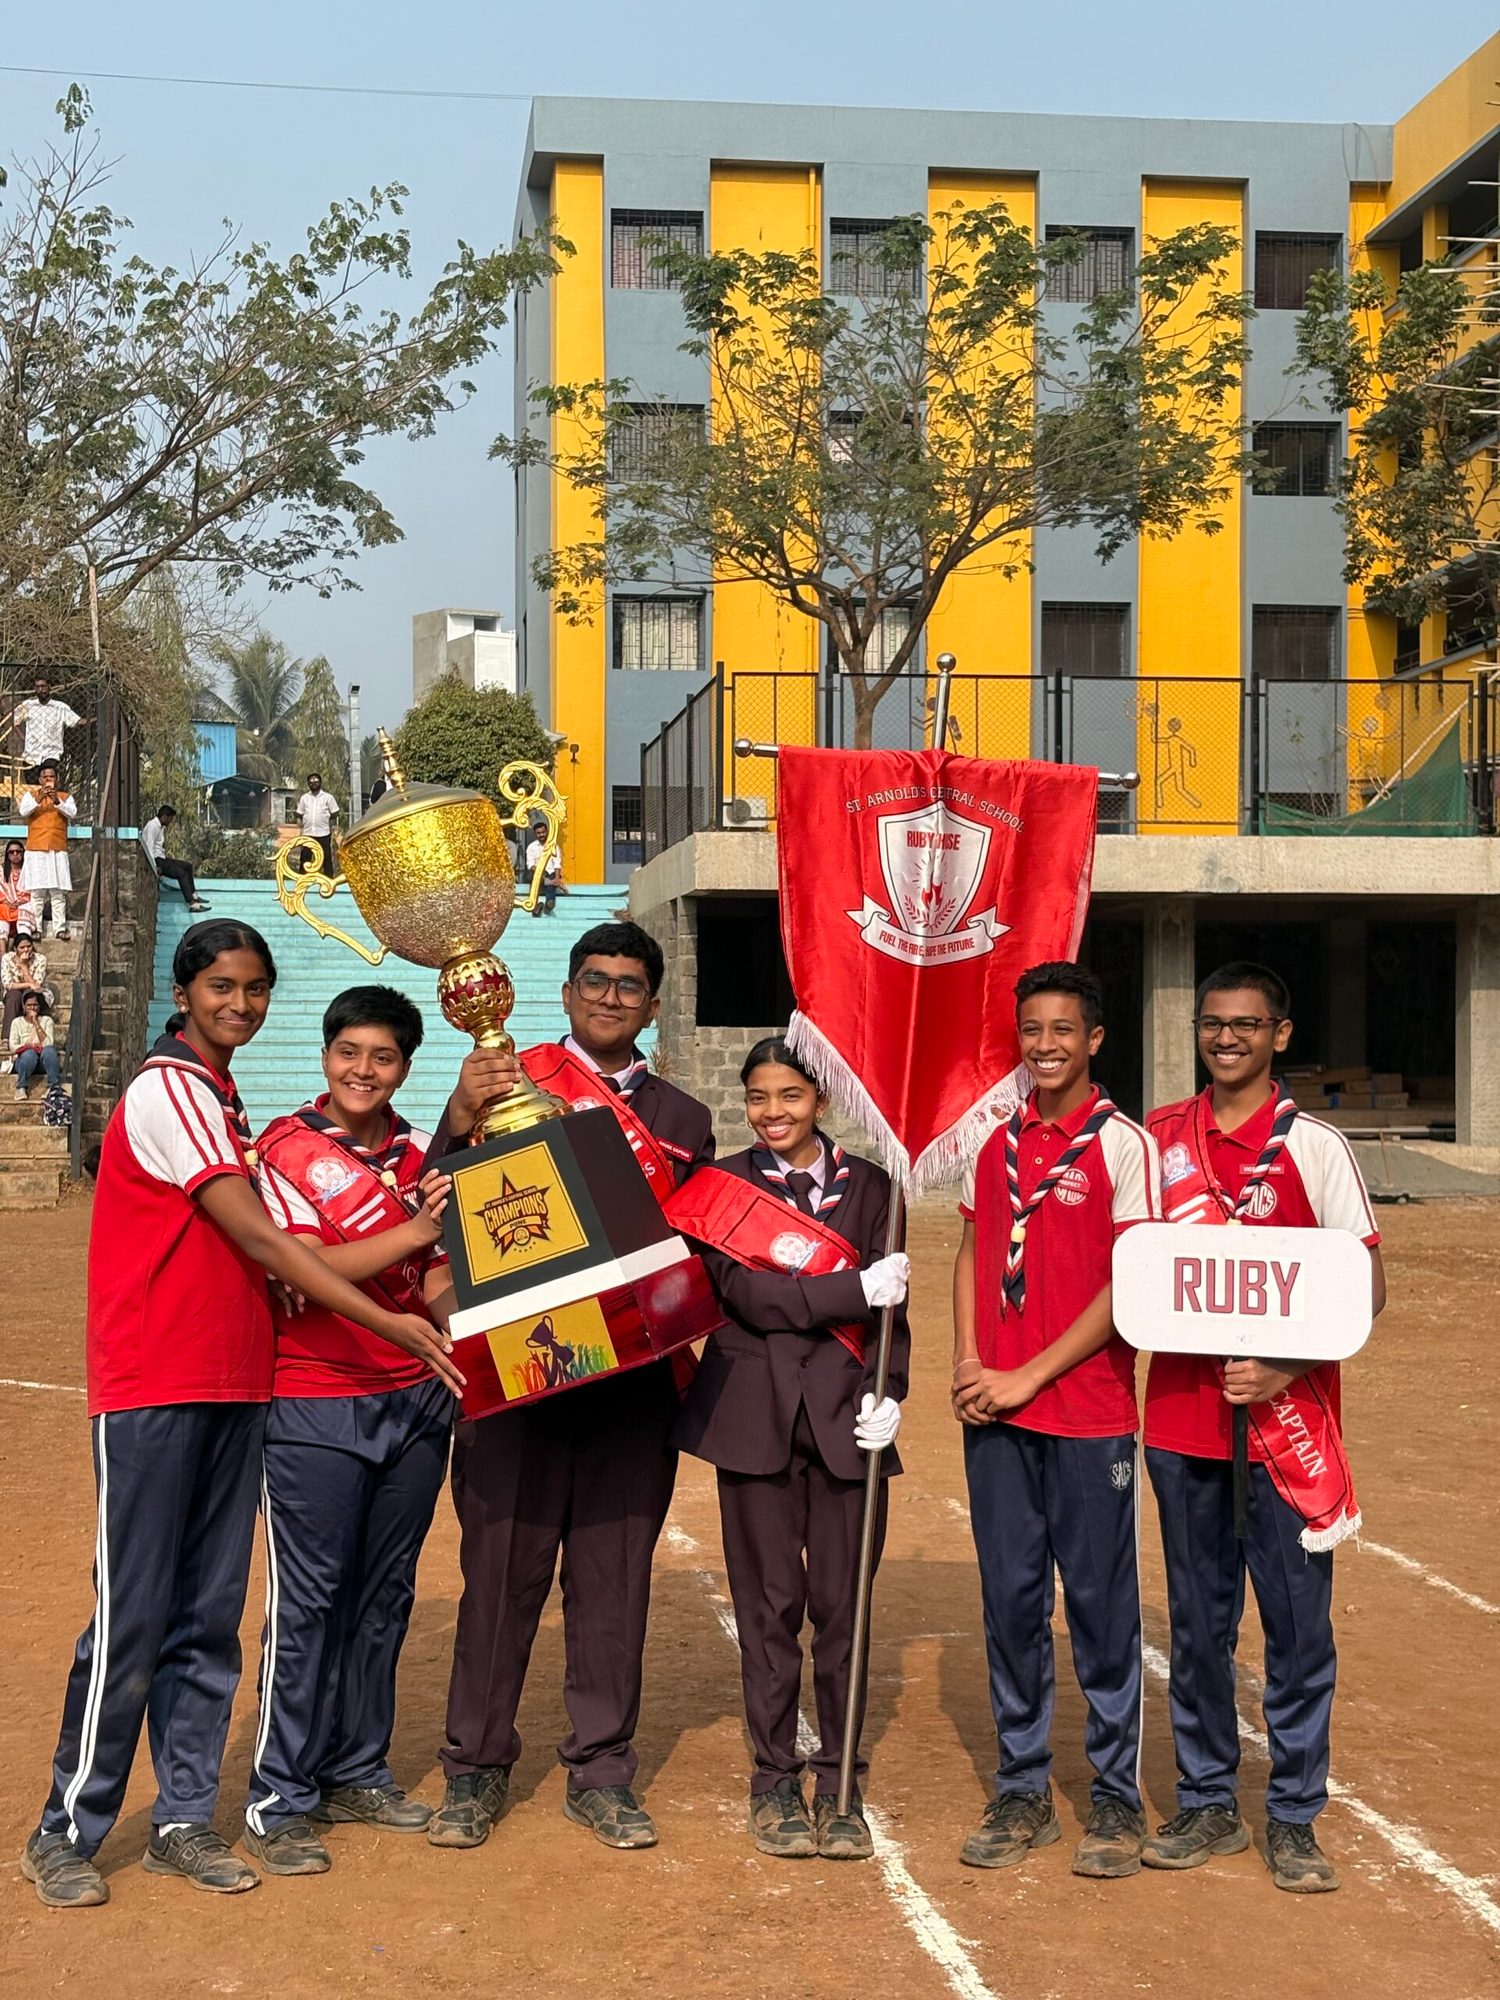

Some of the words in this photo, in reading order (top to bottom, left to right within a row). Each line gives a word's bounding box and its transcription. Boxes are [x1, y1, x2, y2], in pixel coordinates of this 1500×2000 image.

[845, 799, 865, 813] ST.
[867, 786, 926, 807] ARNOLD'S
[930, 786, 975, 807] CETRAL
[978, 800, 1025, 833] SCHOOL
[906, 830, 935, 849] RUBY
[879, 930, 896, 947] FUEL
[948, 937, 976, 954] FUTURE
[483, 1192, 547, 1233] CHAMPIONS
[1246, 1185, 1275, 1216] ACS
[1173, 1257, 1301, 1317] RUBY
